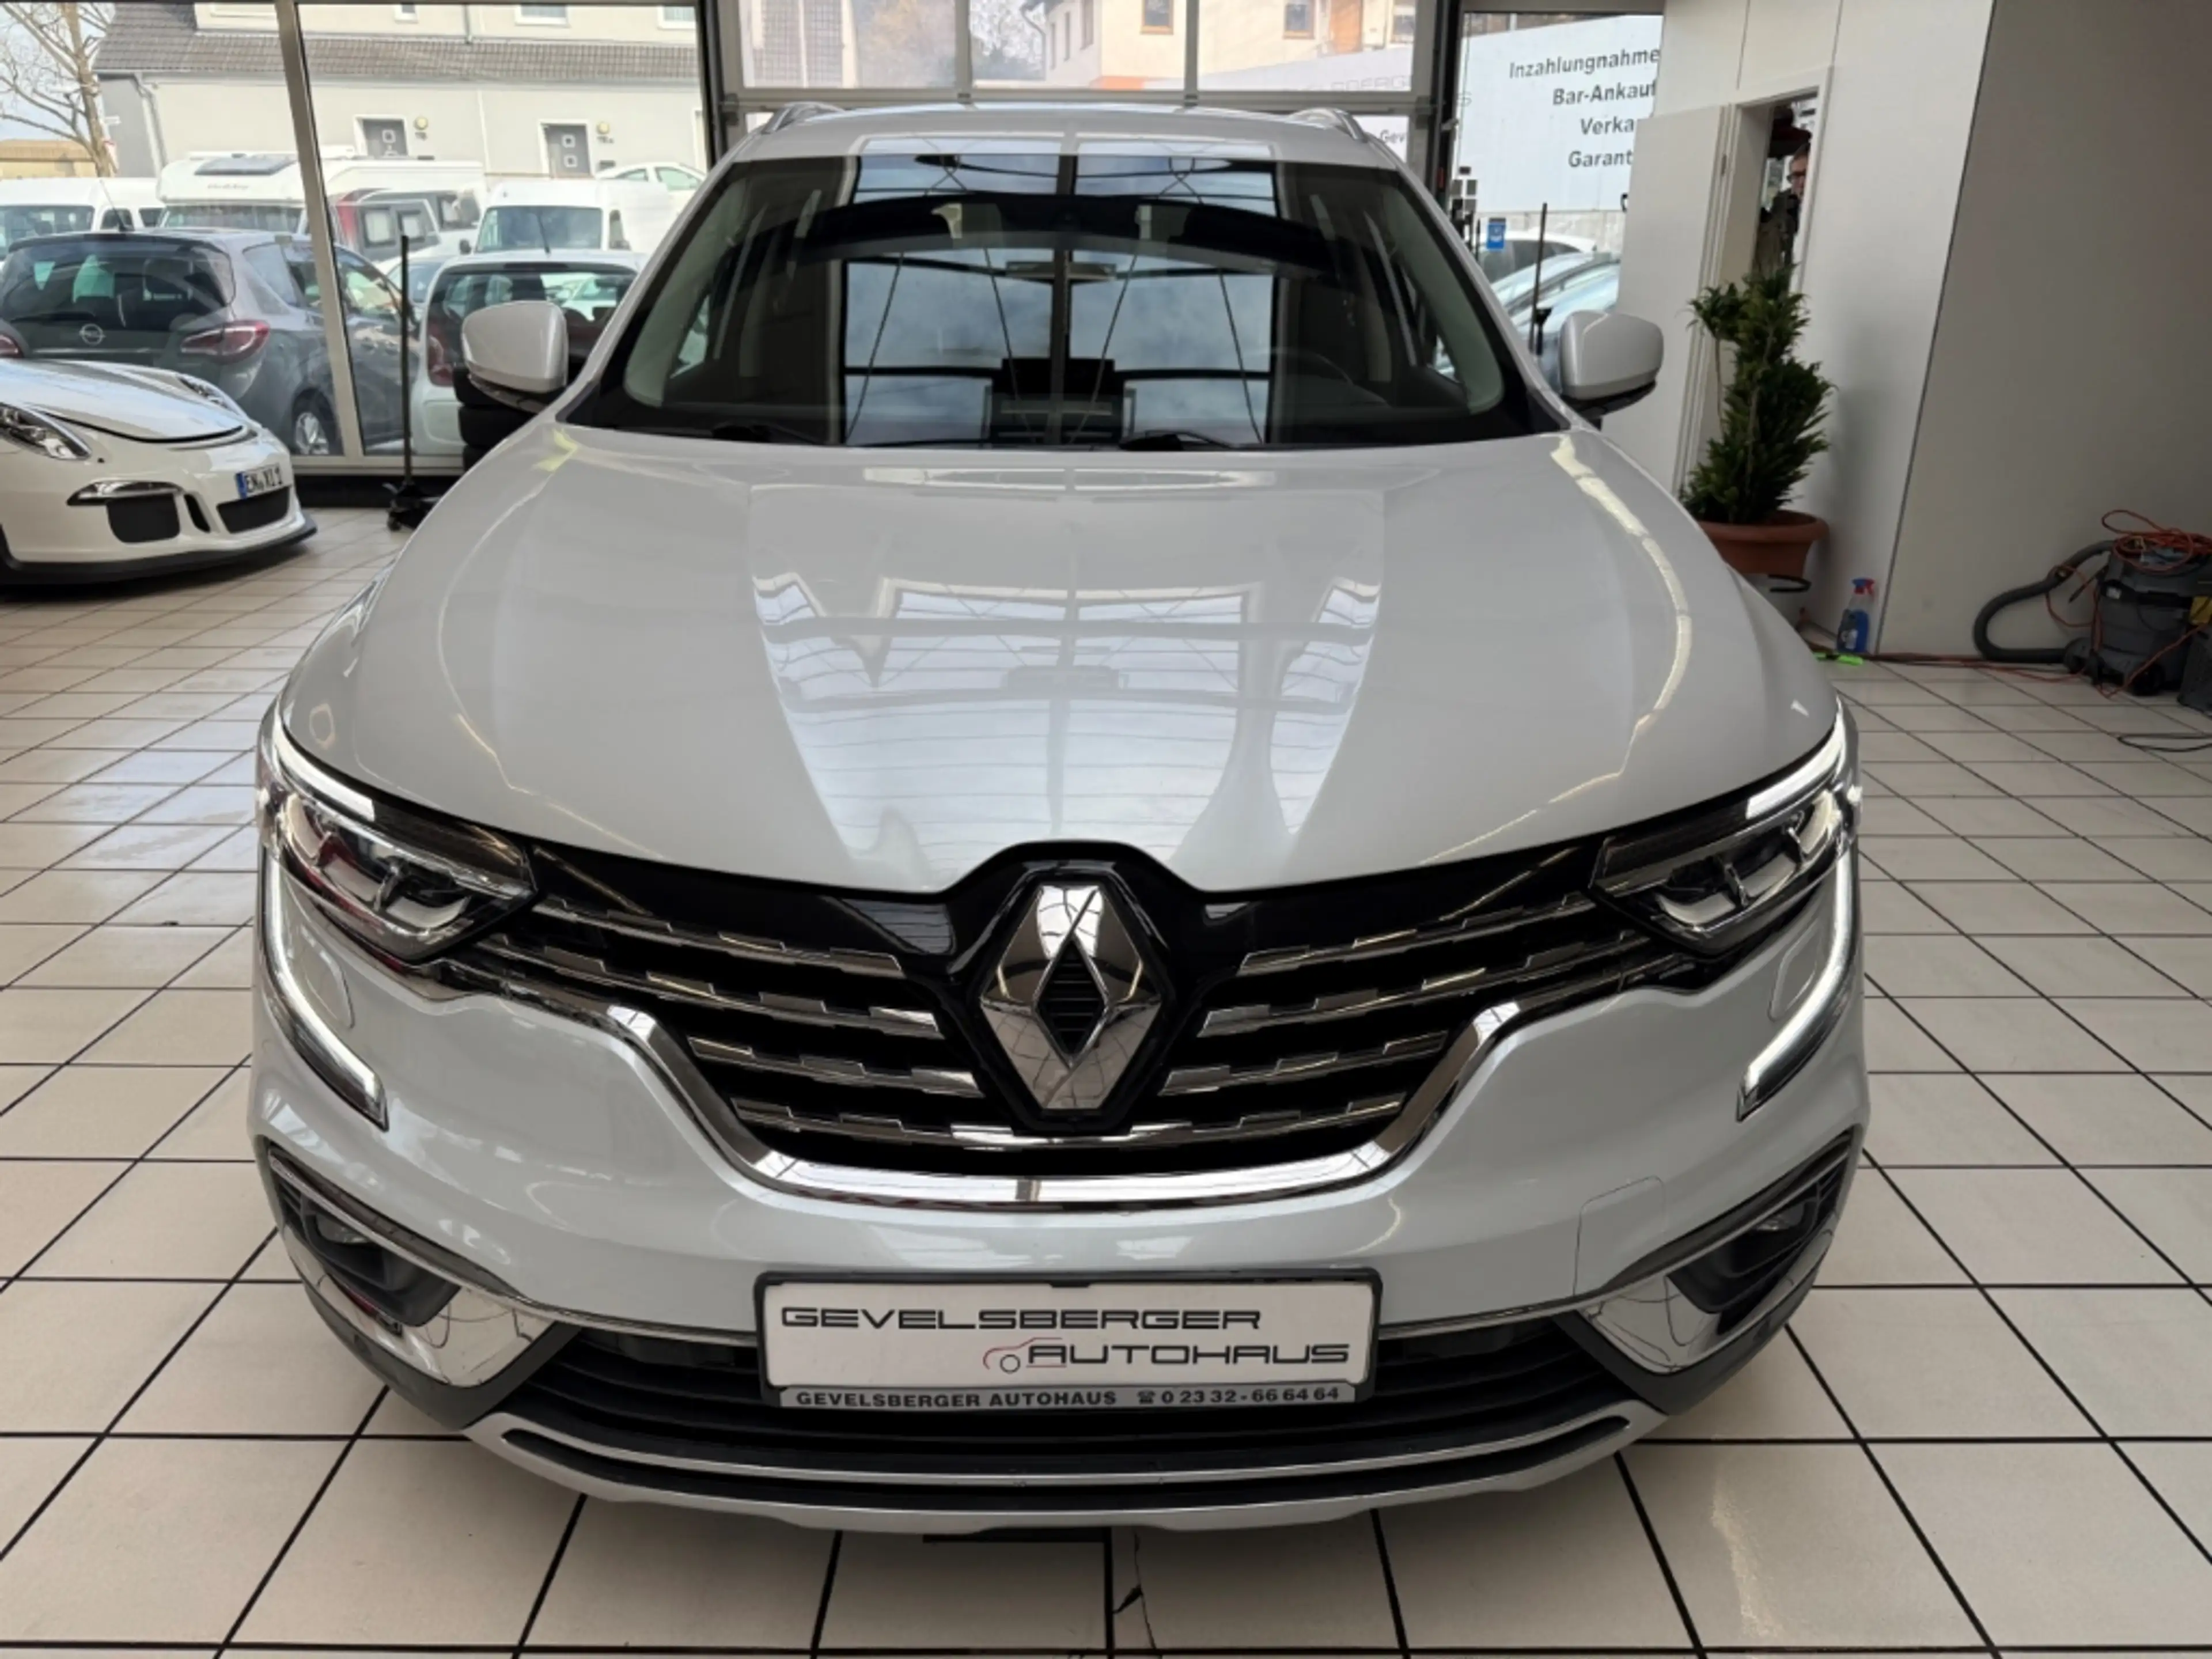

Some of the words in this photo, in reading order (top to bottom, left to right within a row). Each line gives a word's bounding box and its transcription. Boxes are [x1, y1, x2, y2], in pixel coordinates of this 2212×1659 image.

[1509, 48, 1661, 79] Inzahlungnahme
[781, 1306, 1261, 1330] GEVELSBERGER
[1028, 1343, 1350, 1365] AUTOHAUS
[796, 1391, 981, 1408] GEVELSBERGER
[989, 1391, 1116, 1406] AUTOHAUS
